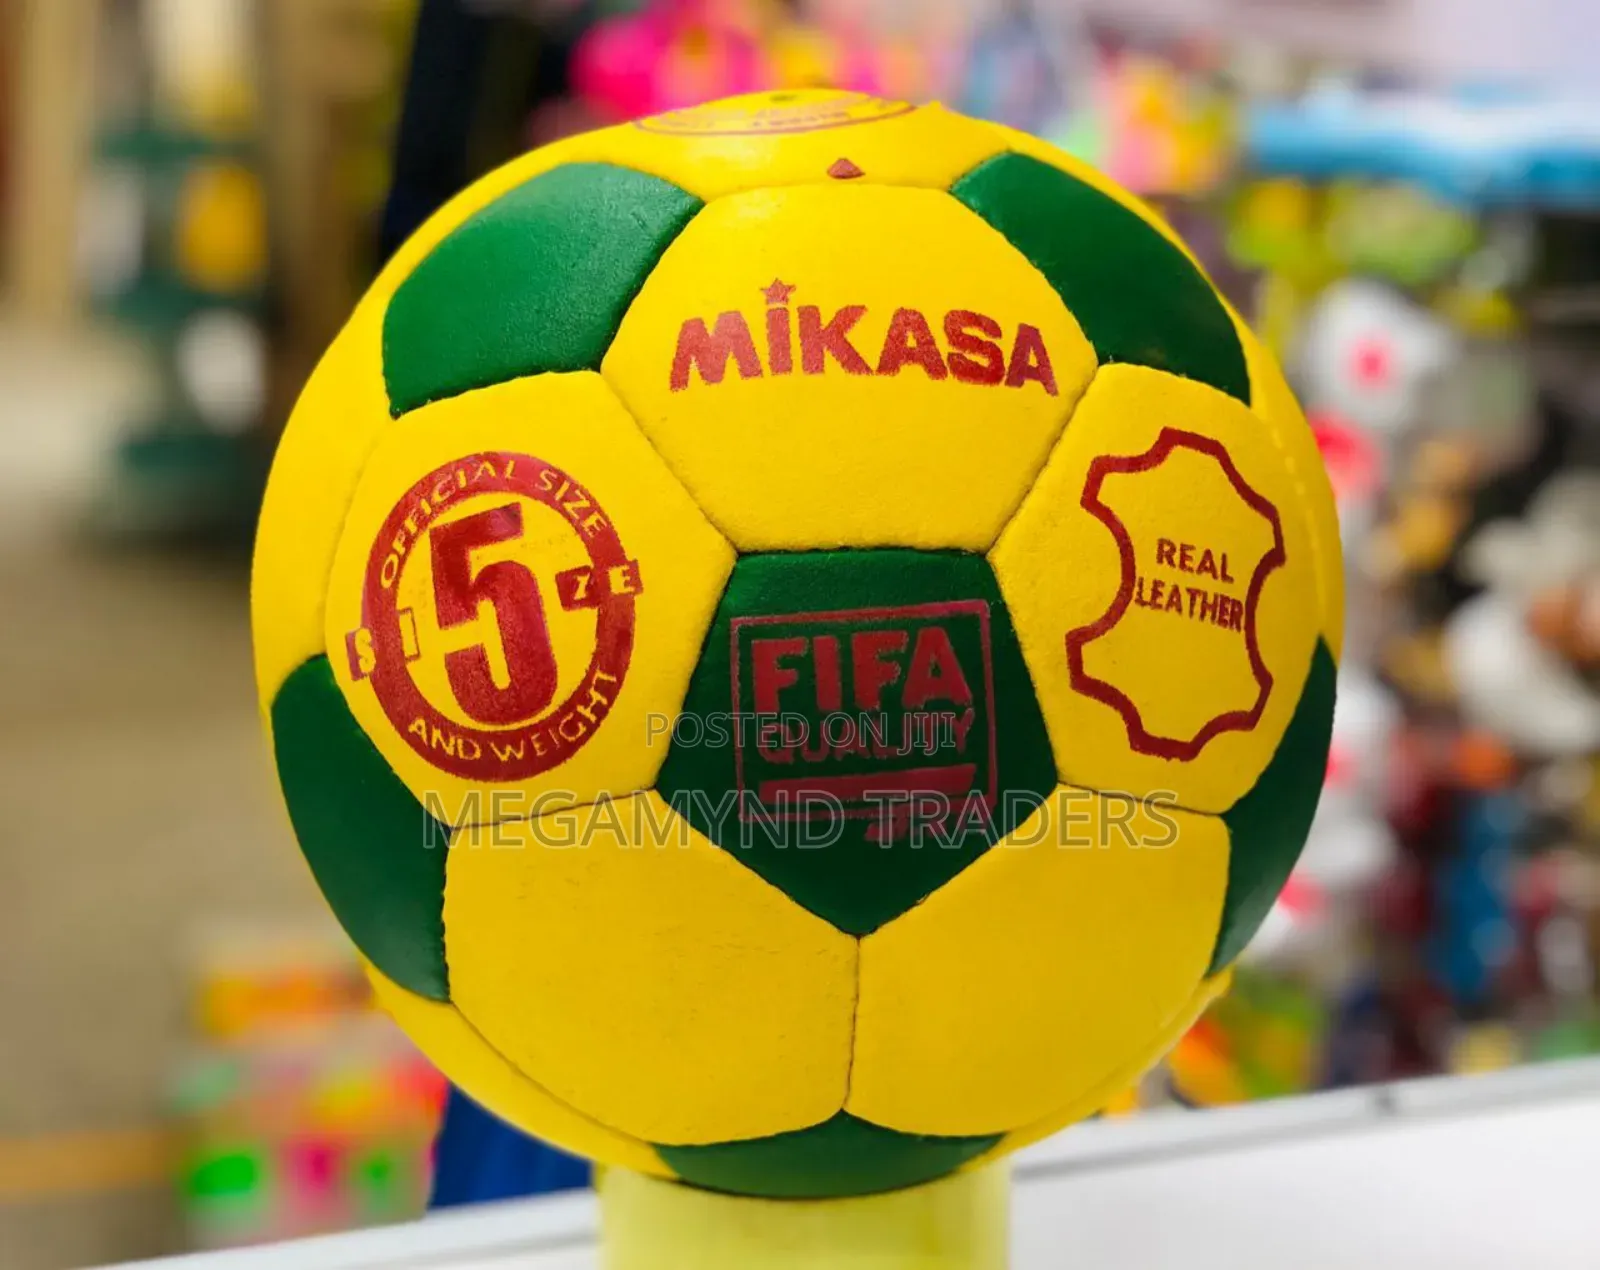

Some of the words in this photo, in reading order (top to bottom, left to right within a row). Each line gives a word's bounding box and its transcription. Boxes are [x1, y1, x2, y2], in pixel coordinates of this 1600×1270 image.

[380, 459, 515, 590] OFFICIAL
[535, 468, 608, 538] SIZE
[1155, 537, 1235, 585] REAL
[429, 501, 558, 726] 5
[1134, 576, 1246, 633] LEATHER
[751, 626, 972, 713] FIFA
[408, 717, 482, 761] AND
[490, 670, 617, 762] WEIGHT
[757, 707, 975, 764] QUALITY
